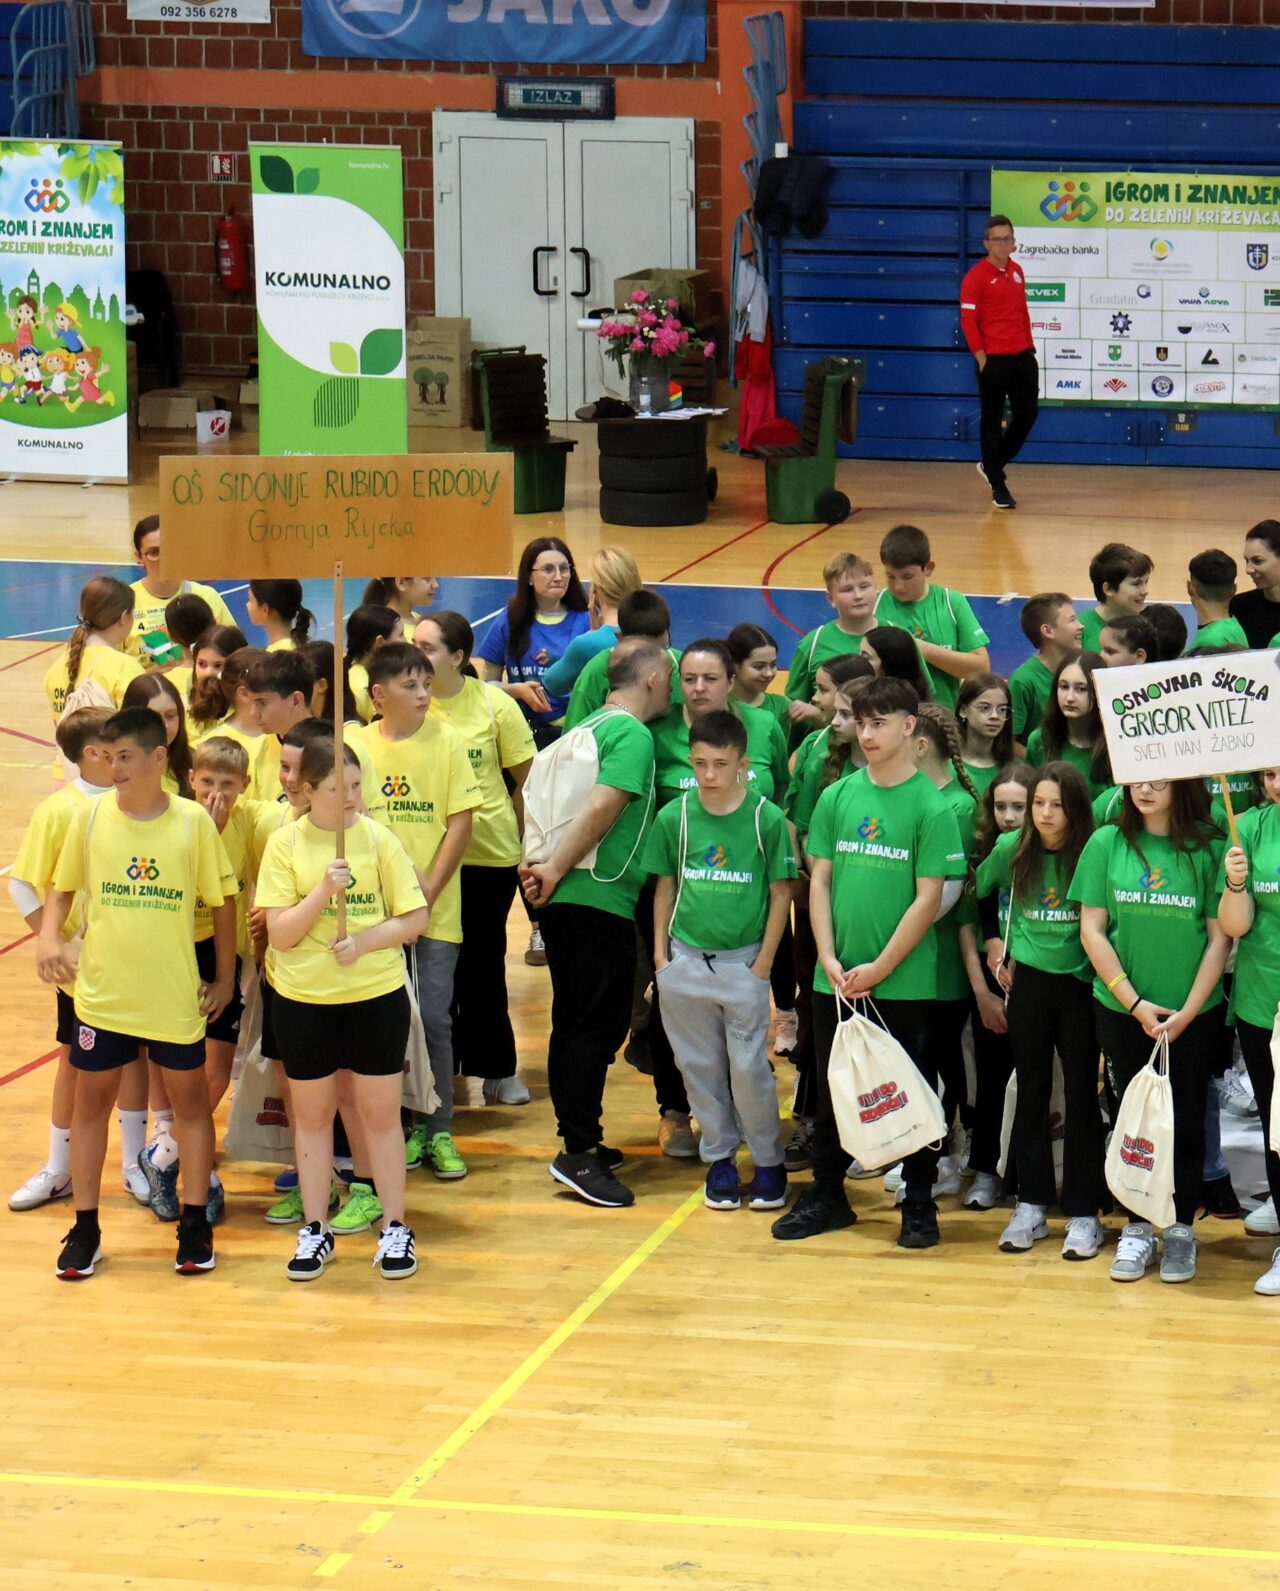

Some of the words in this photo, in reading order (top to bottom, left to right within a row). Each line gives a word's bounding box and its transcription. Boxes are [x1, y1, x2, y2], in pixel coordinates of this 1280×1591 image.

[160, 7, 181, 17] 092
[185, 7, 206, 18] 356
[209, 7, 237, 18] 6278
[530, 90, 572, 103] IZLAZ
[1105, 181, 1169, 203] IGROM
[1105, 207, 1125, 222] DO
[41, 222, 114, 239] ZNANJEM
[1018, 243, 1070, 256] Zagrebačka
[1072, 244, 1100, 255] banka
[265, 271, 391, 291] KOMUNALNO
[1056, 380, 1082, 389] AMK
[17, 438, 84, 450] KOMUNALNO
[172, 469, 204, 505] OŠ
[218, 471, 309, 508] SIDONIJE
[324, 468, 399, 499] RUBIDO
[248, 508, 331, 550] Gornja
[344, 506, 416, 550] Rijeka
[1111, 671, 1203, 716] OSNOVNA
[1211, 667, 1269, 702] ŠKOLA
[1134, 742, 1166, 761] SVETI
[1174, 740, 1201, 756] IVAN
[1211, 732, 1255, 753] ŽABNO
[393, 801, 434, 813] ZNANJEM
[836, 840, 859, 854] IGROM
[865, 843, 909, 860] ZNANJEM
[102, 881, 131, 897] IGROM
[139, 885, 184, 901] ZNANJEM
[1149, 893, 1196, 909] ZNANJEM
[1046, 910, 1080, 922] ZNANJ
